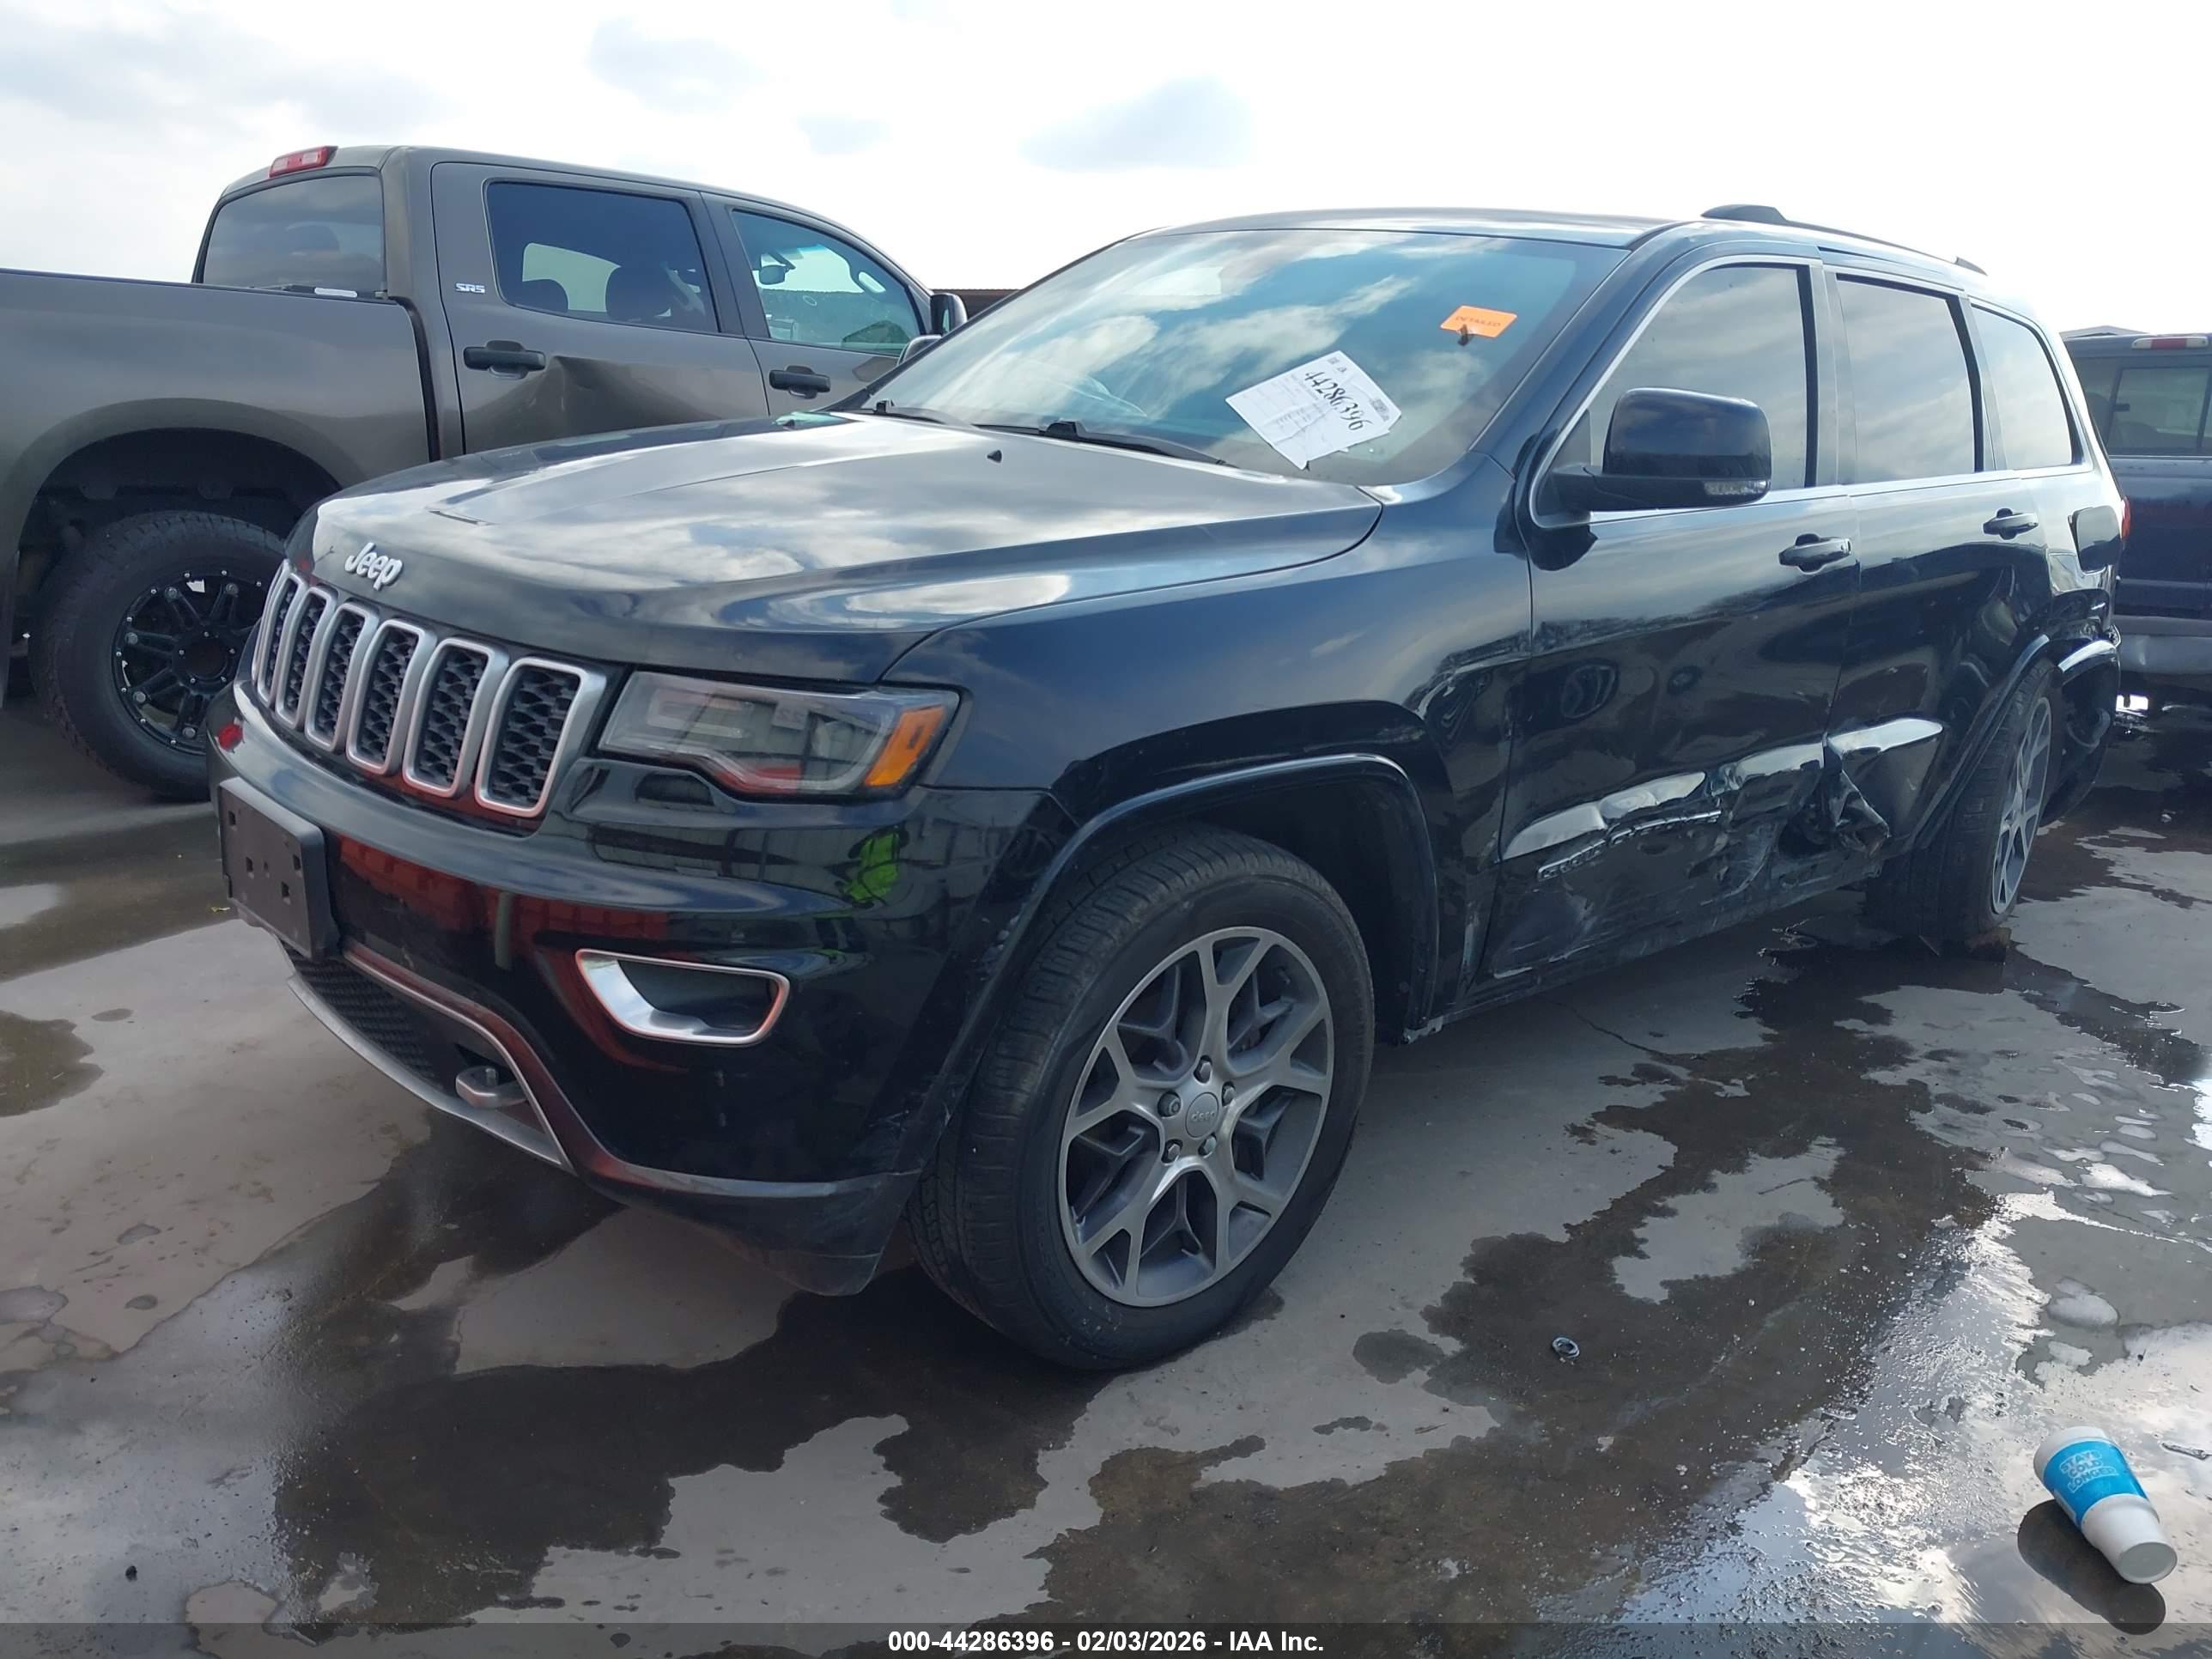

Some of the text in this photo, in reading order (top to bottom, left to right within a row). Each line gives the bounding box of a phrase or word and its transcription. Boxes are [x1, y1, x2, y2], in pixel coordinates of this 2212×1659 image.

[1304, 371, 1375, 431] 44286396
[344, 542, 403, 592] Jeep
[2060, 1450, 2101, 1473] STAYS
[2069, 1460, 2102, 1477] COLD
